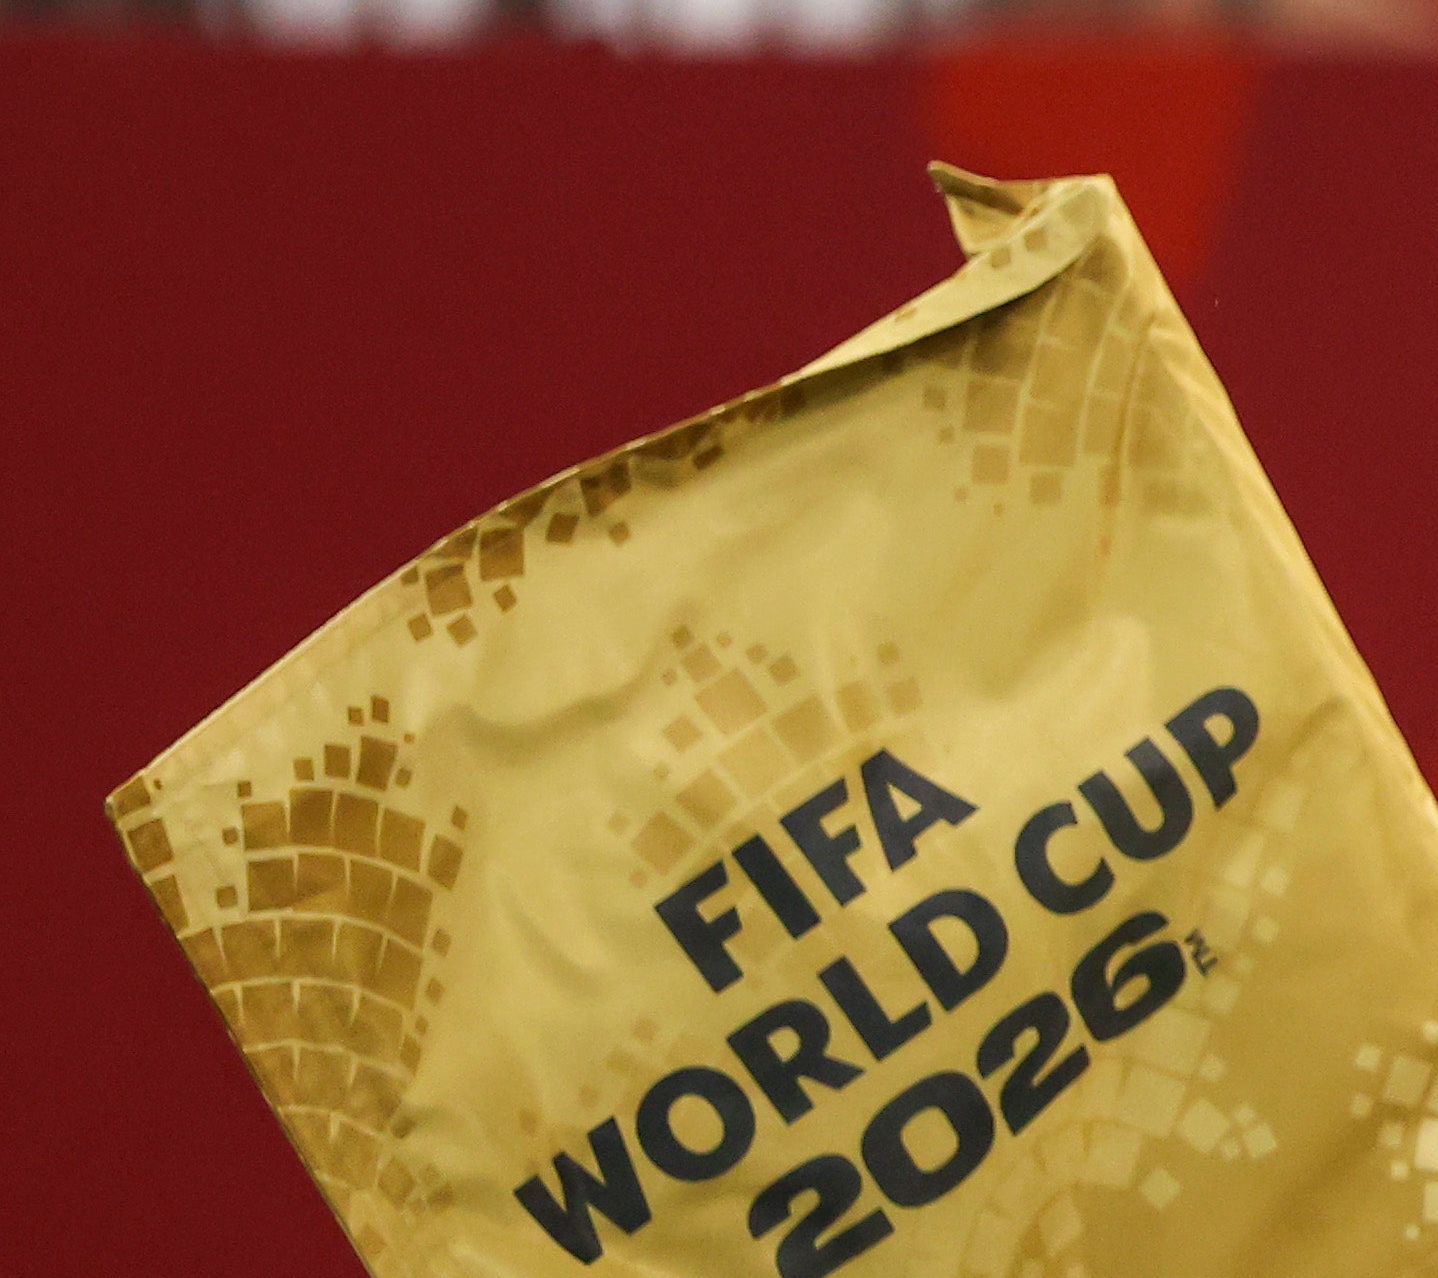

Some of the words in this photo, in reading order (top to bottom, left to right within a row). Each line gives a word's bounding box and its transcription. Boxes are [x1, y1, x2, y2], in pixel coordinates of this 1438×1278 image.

[513, 889, 1009, 1266] WORLD
[1013, 688, 1261, 916] CUP
[654, 749, 978, 993] FIFA
